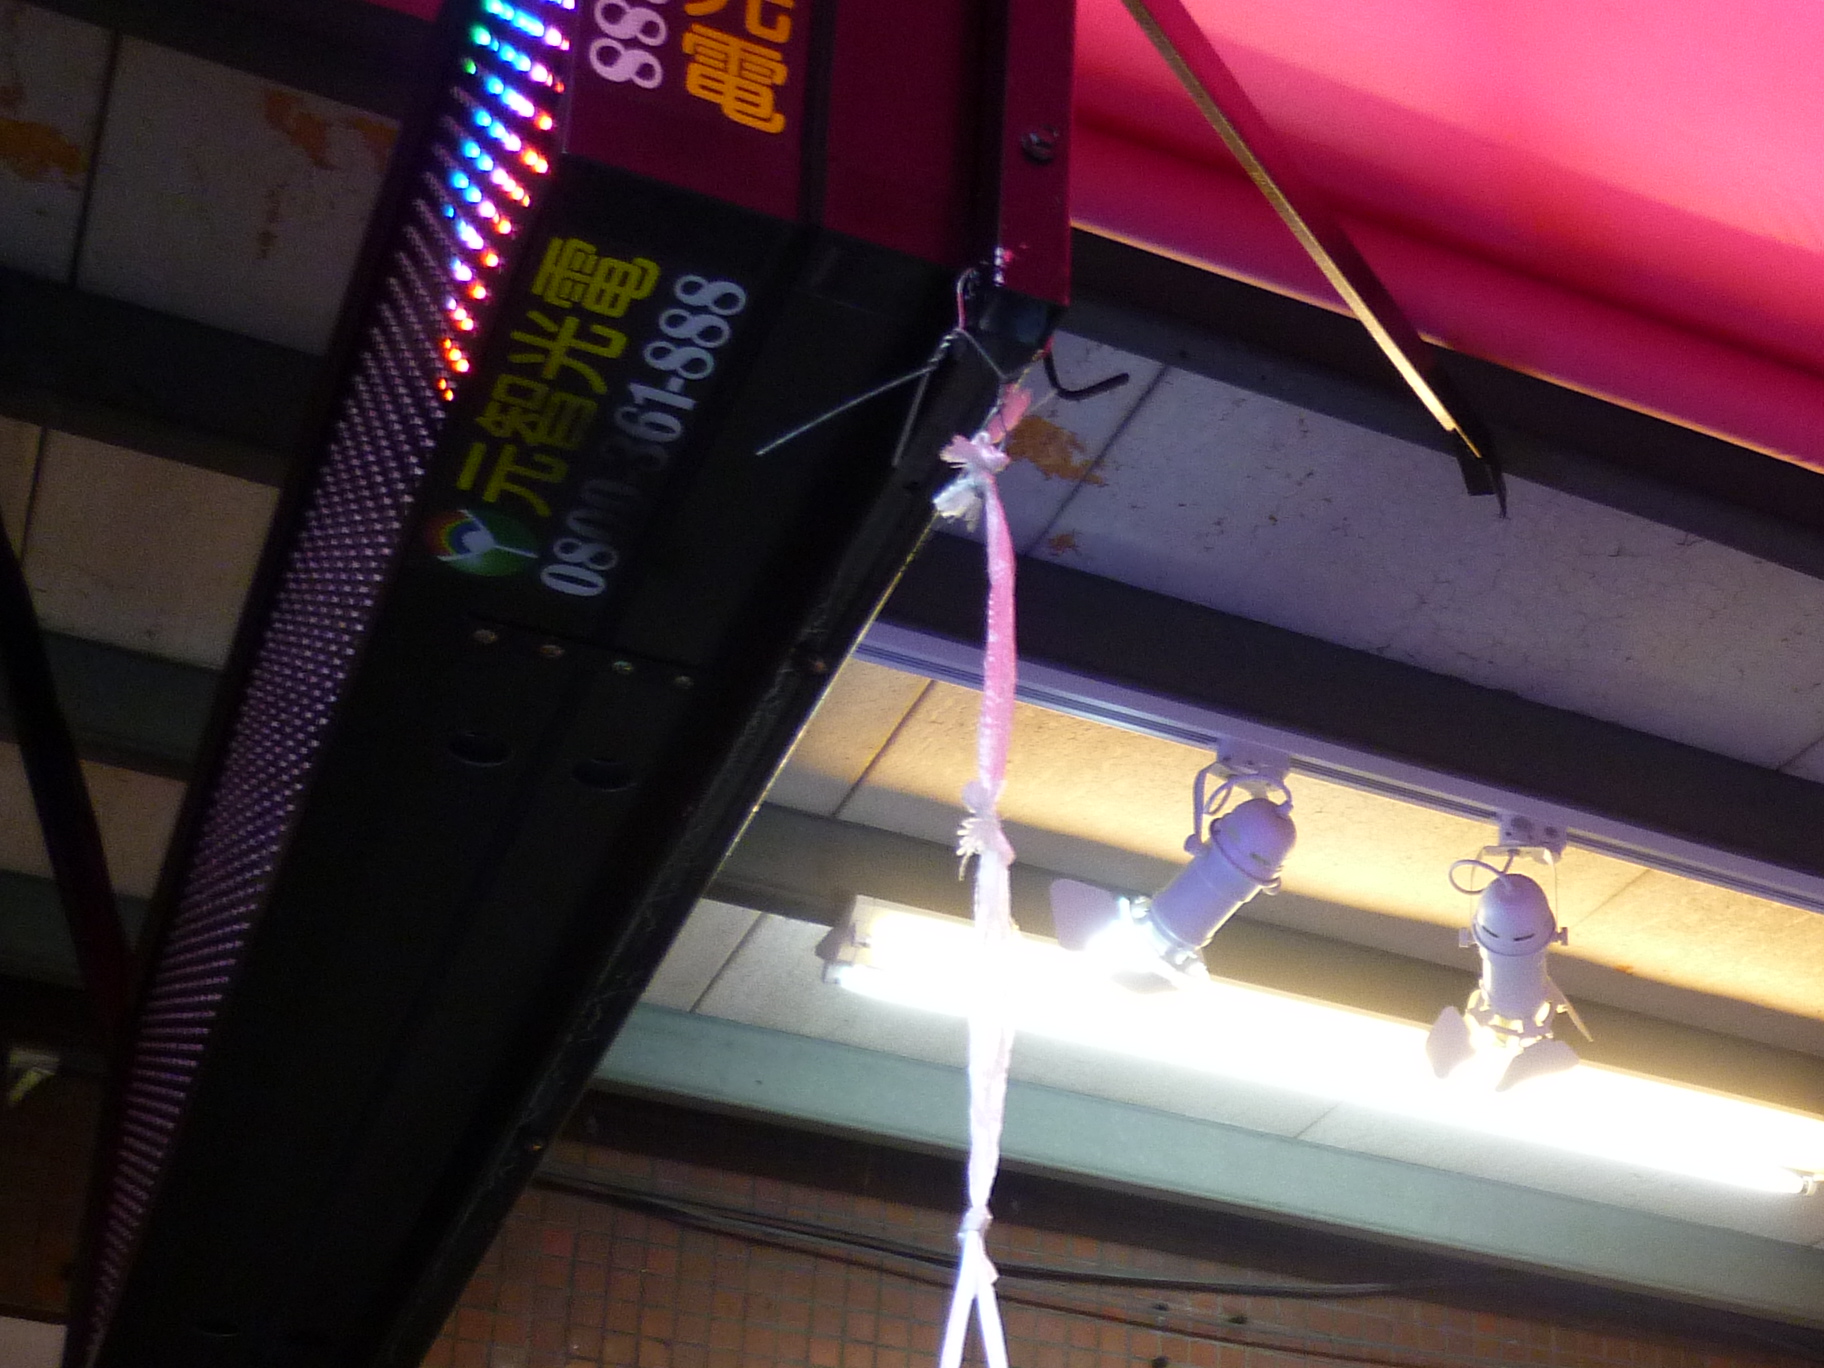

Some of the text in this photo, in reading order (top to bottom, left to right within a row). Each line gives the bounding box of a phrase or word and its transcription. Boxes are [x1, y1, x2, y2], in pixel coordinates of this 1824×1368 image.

[589, 0, 669, 89] 88
[456, 237, 660, 518] 元智光電
